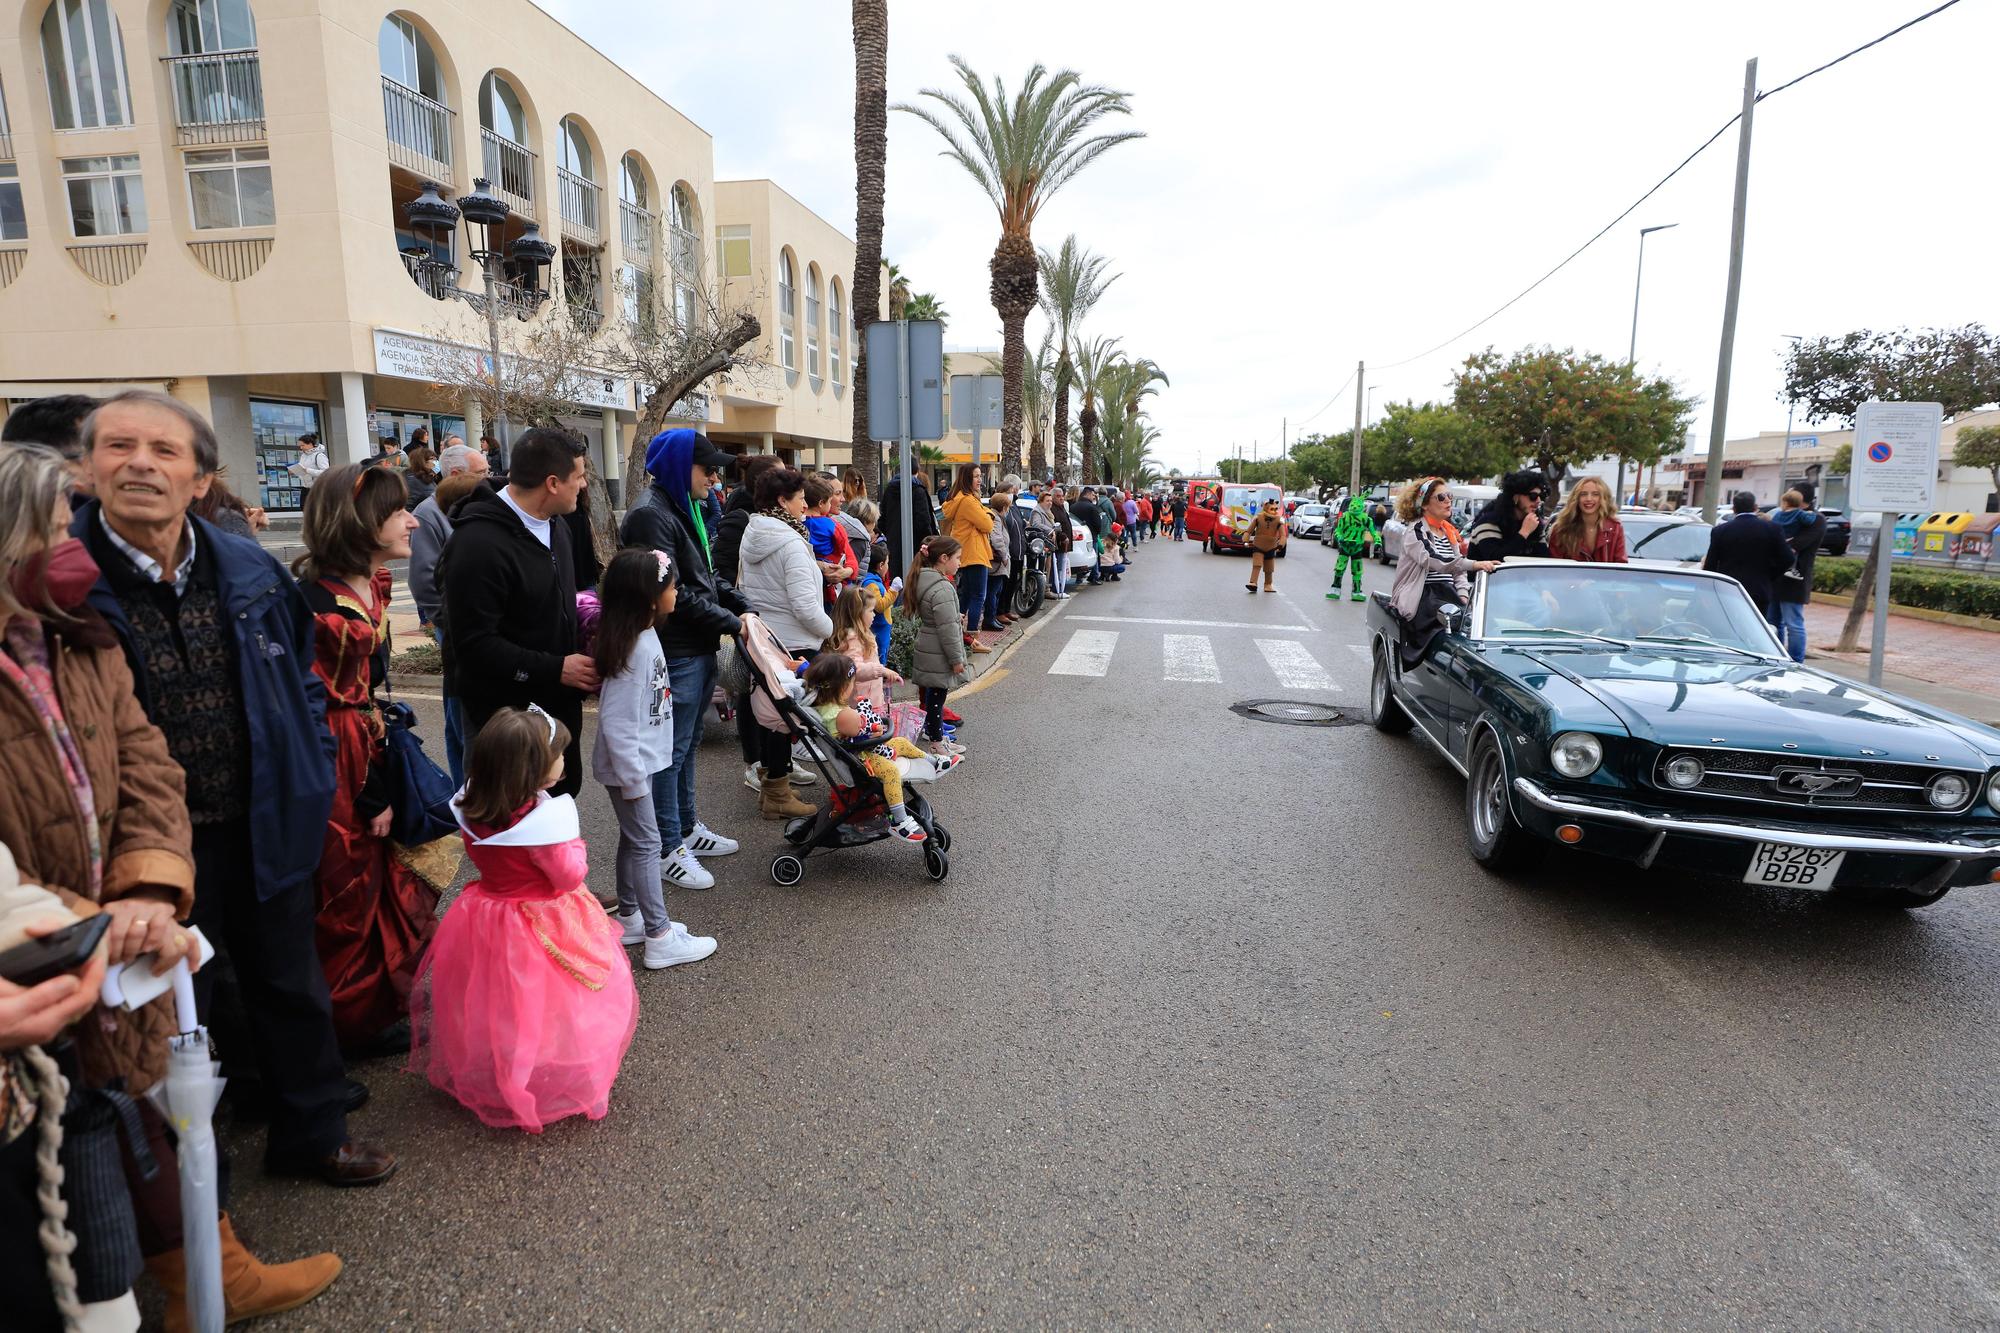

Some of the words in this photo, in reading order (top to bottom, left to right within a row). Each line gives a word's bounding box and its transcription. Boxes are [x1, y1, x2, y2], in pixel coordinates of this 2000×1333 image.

[381, 349, 420, 364] AGENCIA
[1757, 843, 1842, 867] H3267
[1761, 863, 1818, 885] BBB
